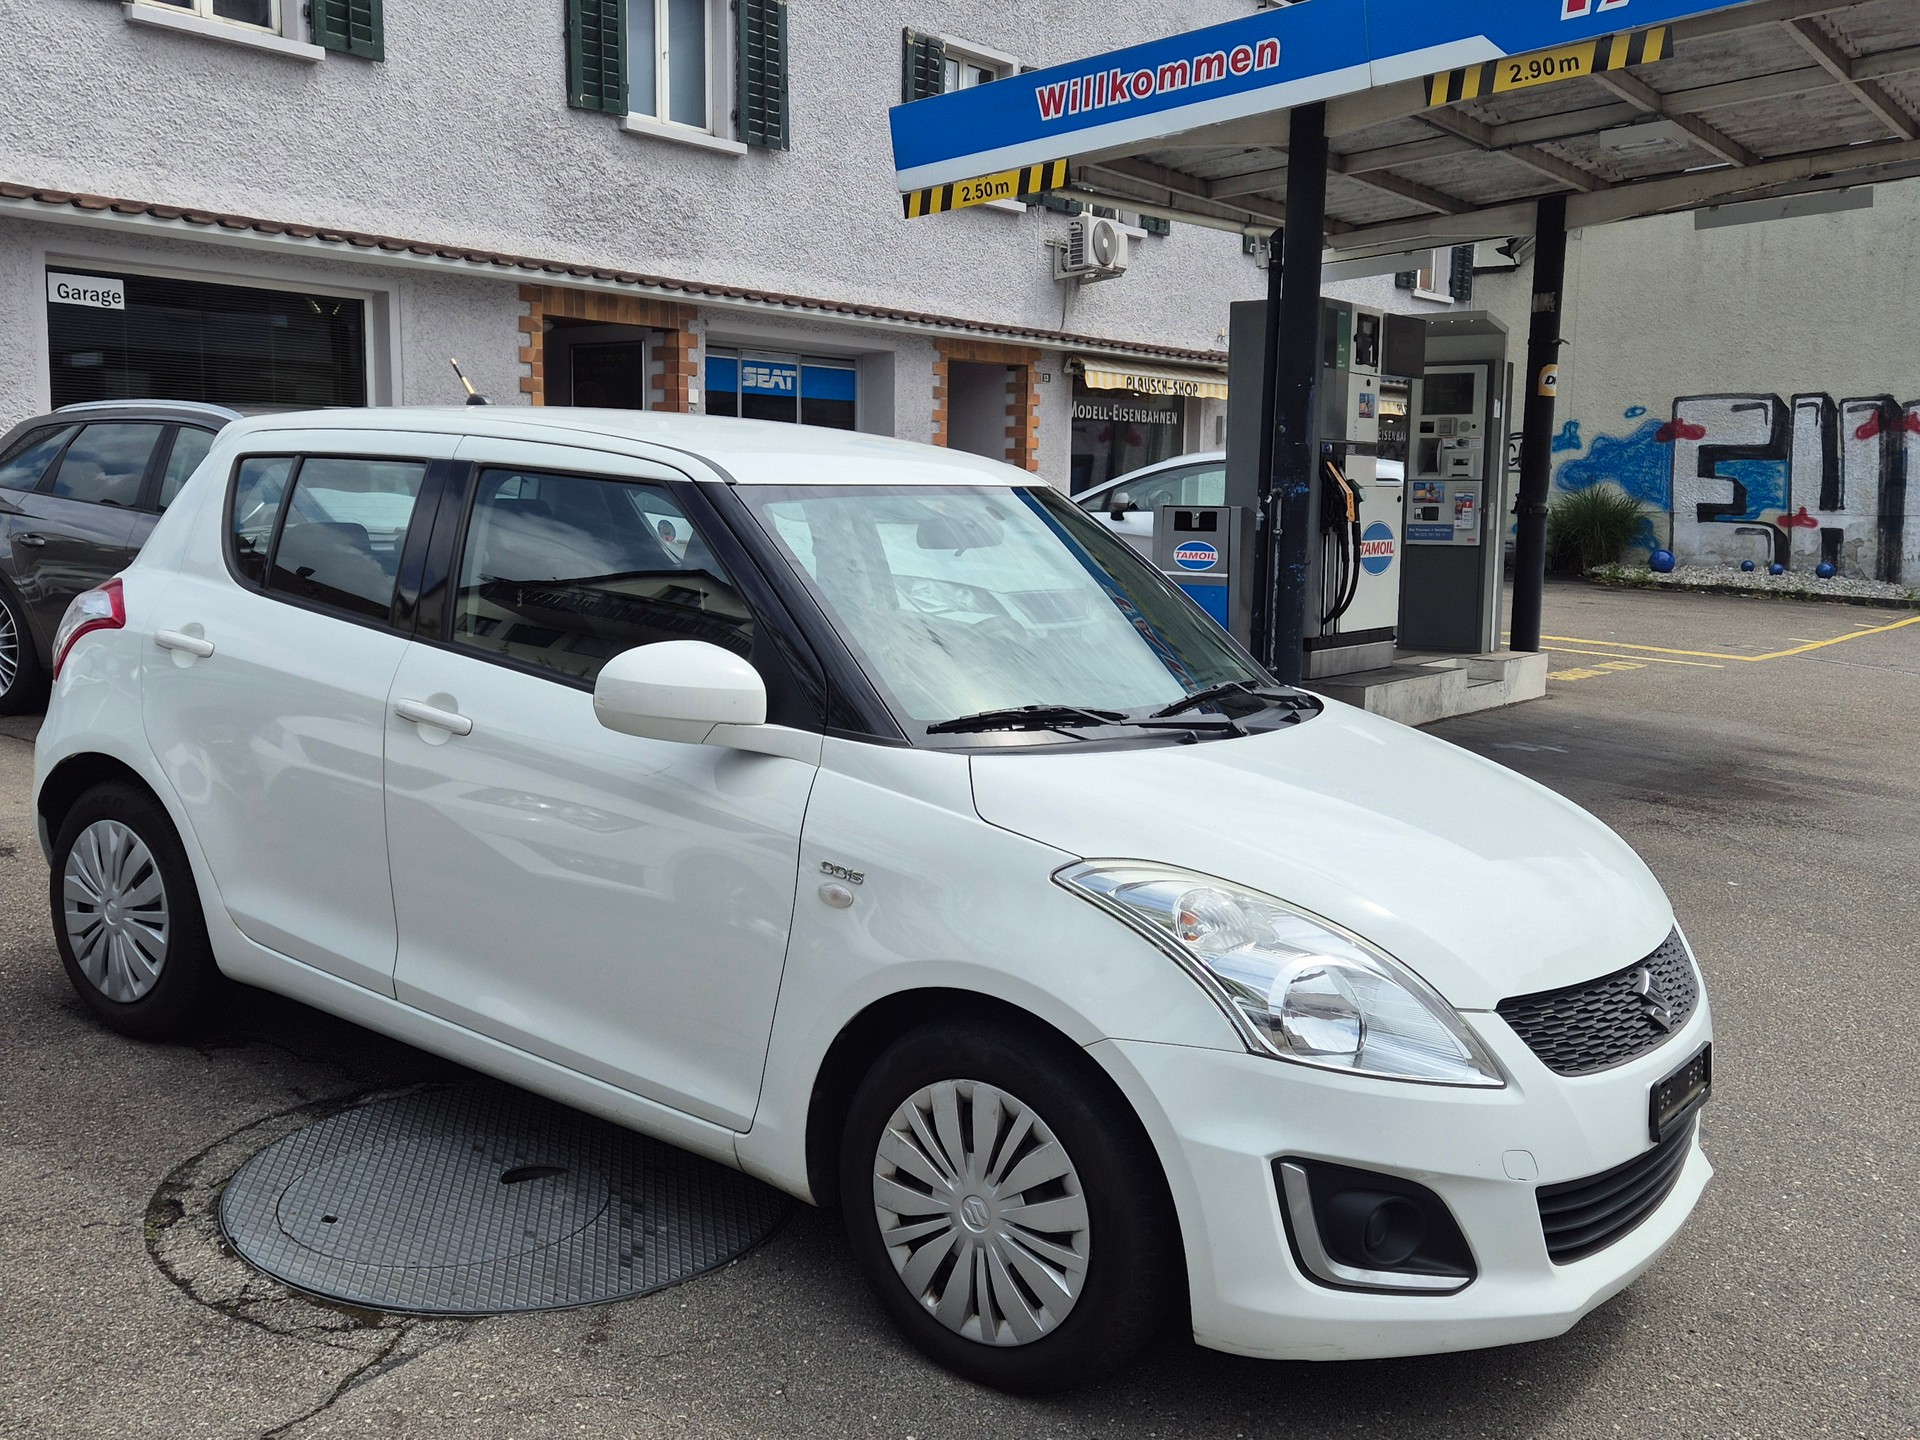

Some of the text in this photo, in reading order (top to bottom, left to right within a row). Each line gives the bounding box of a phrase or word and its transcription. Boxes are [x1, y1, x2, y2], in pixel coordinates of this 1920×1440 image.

[1036, 38, 1281, 121] Willkommen
[1509, 57, 1555, 83] 2.90
[961, 181, 993, 202] 2.50
[56, 282, 122, 307] Garage
[742, 366, 797, 391] SEAT
[1126, 376, 1198, 396] PLAUSCH-SHOP
[1175, 551, 1217, 561] TAMOIL
[1360, 541, 1394, 556] TAMOIL
